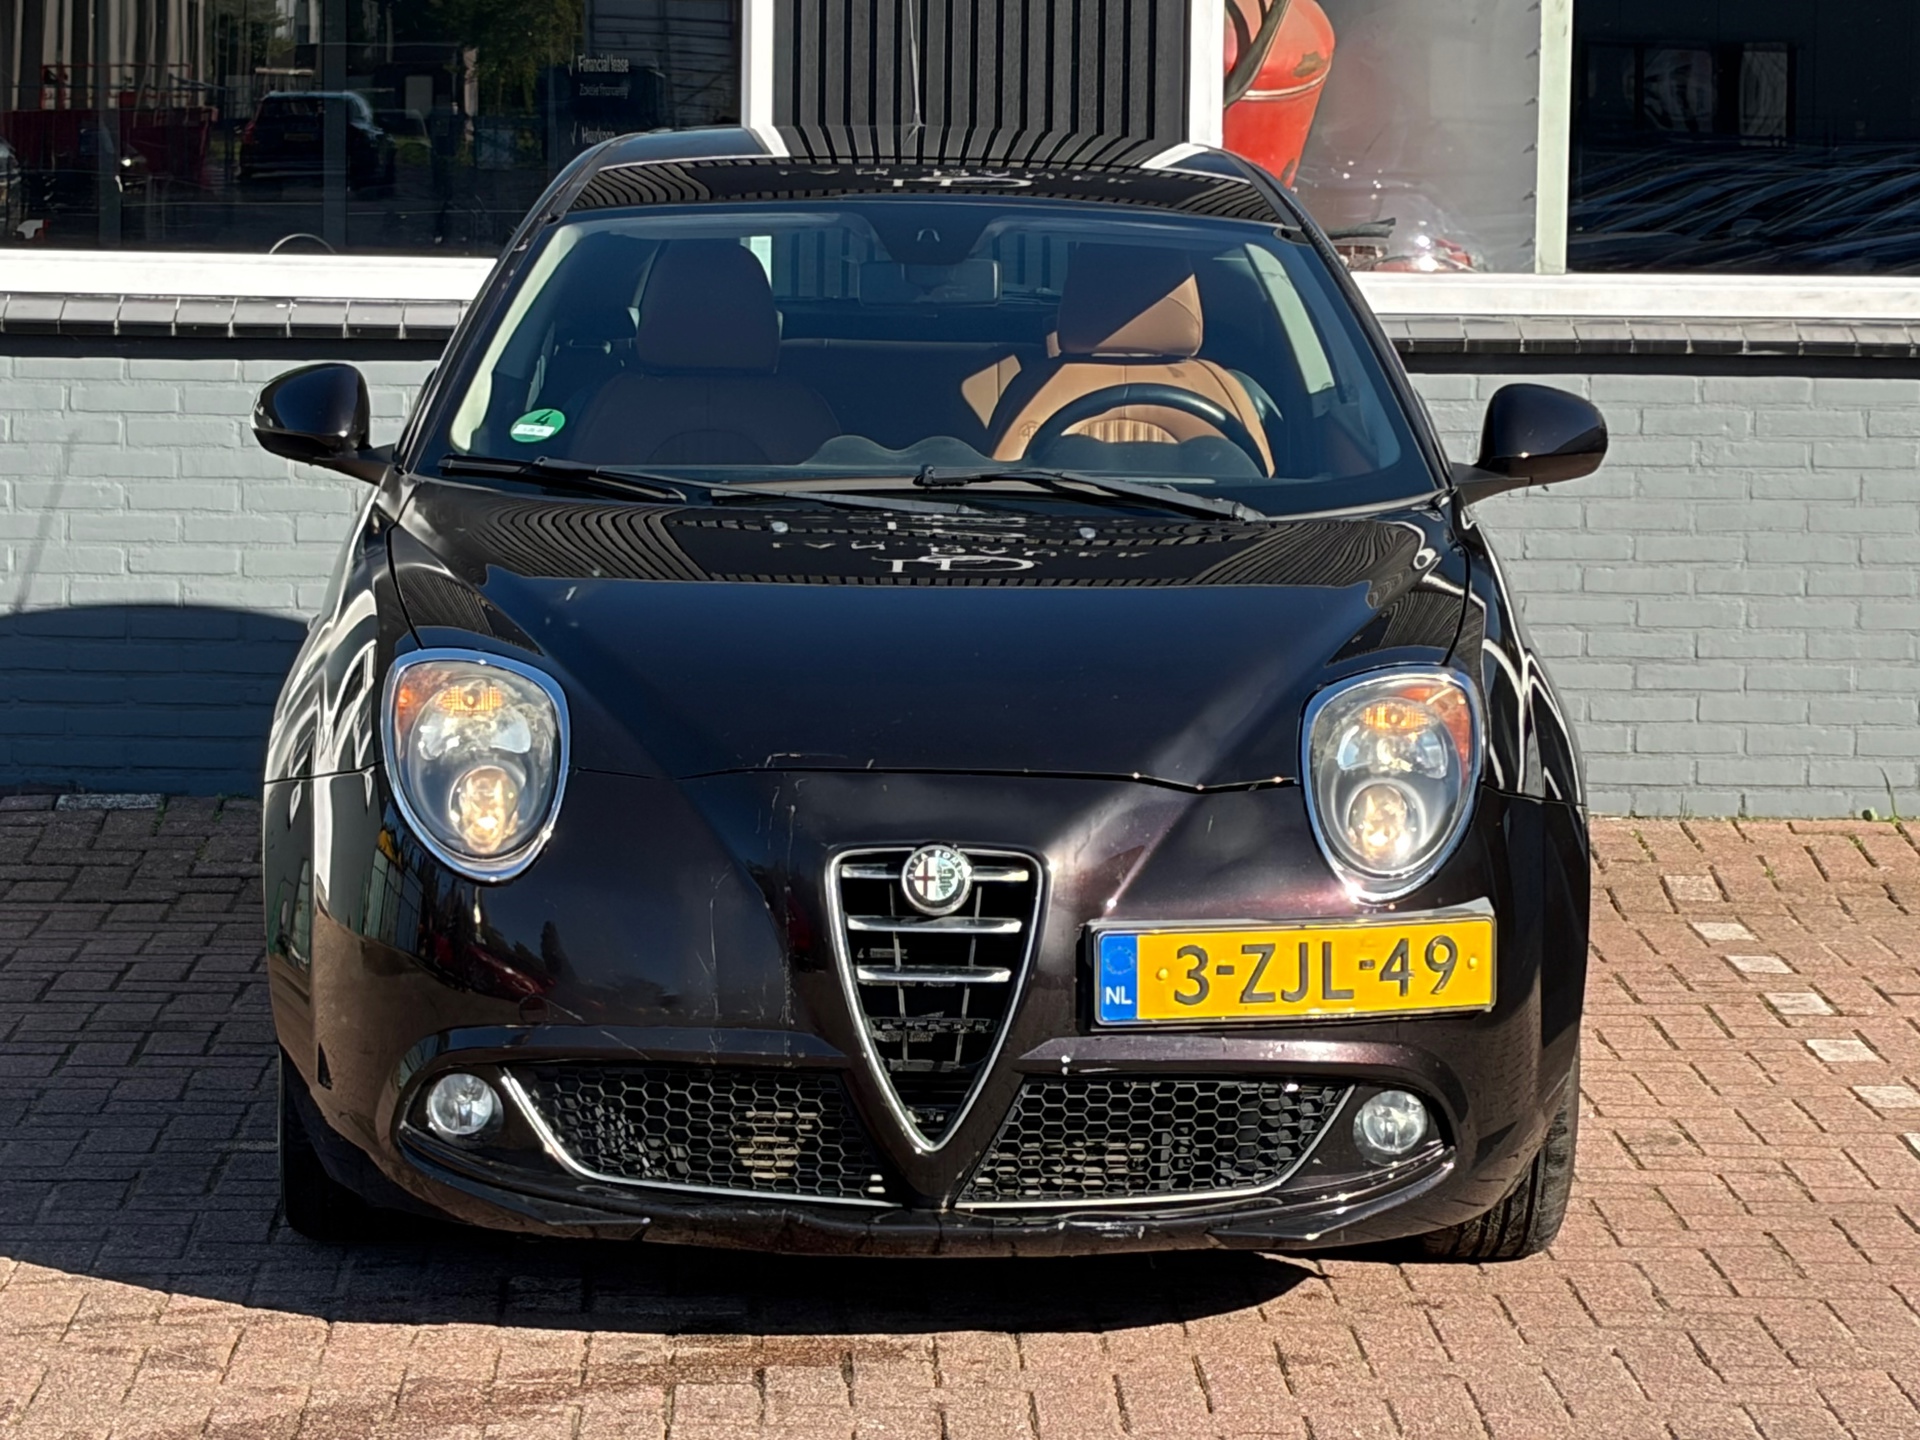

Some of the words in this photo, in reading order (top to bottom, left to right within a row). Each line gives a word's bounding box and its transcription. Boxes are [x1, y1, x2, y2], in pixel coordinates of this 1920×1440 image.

[534, 410, 554, 426] 4
[1174, 934, 1459, 1006] 3-ZJL-49
[1105, 986, 1132, 1005] NL
